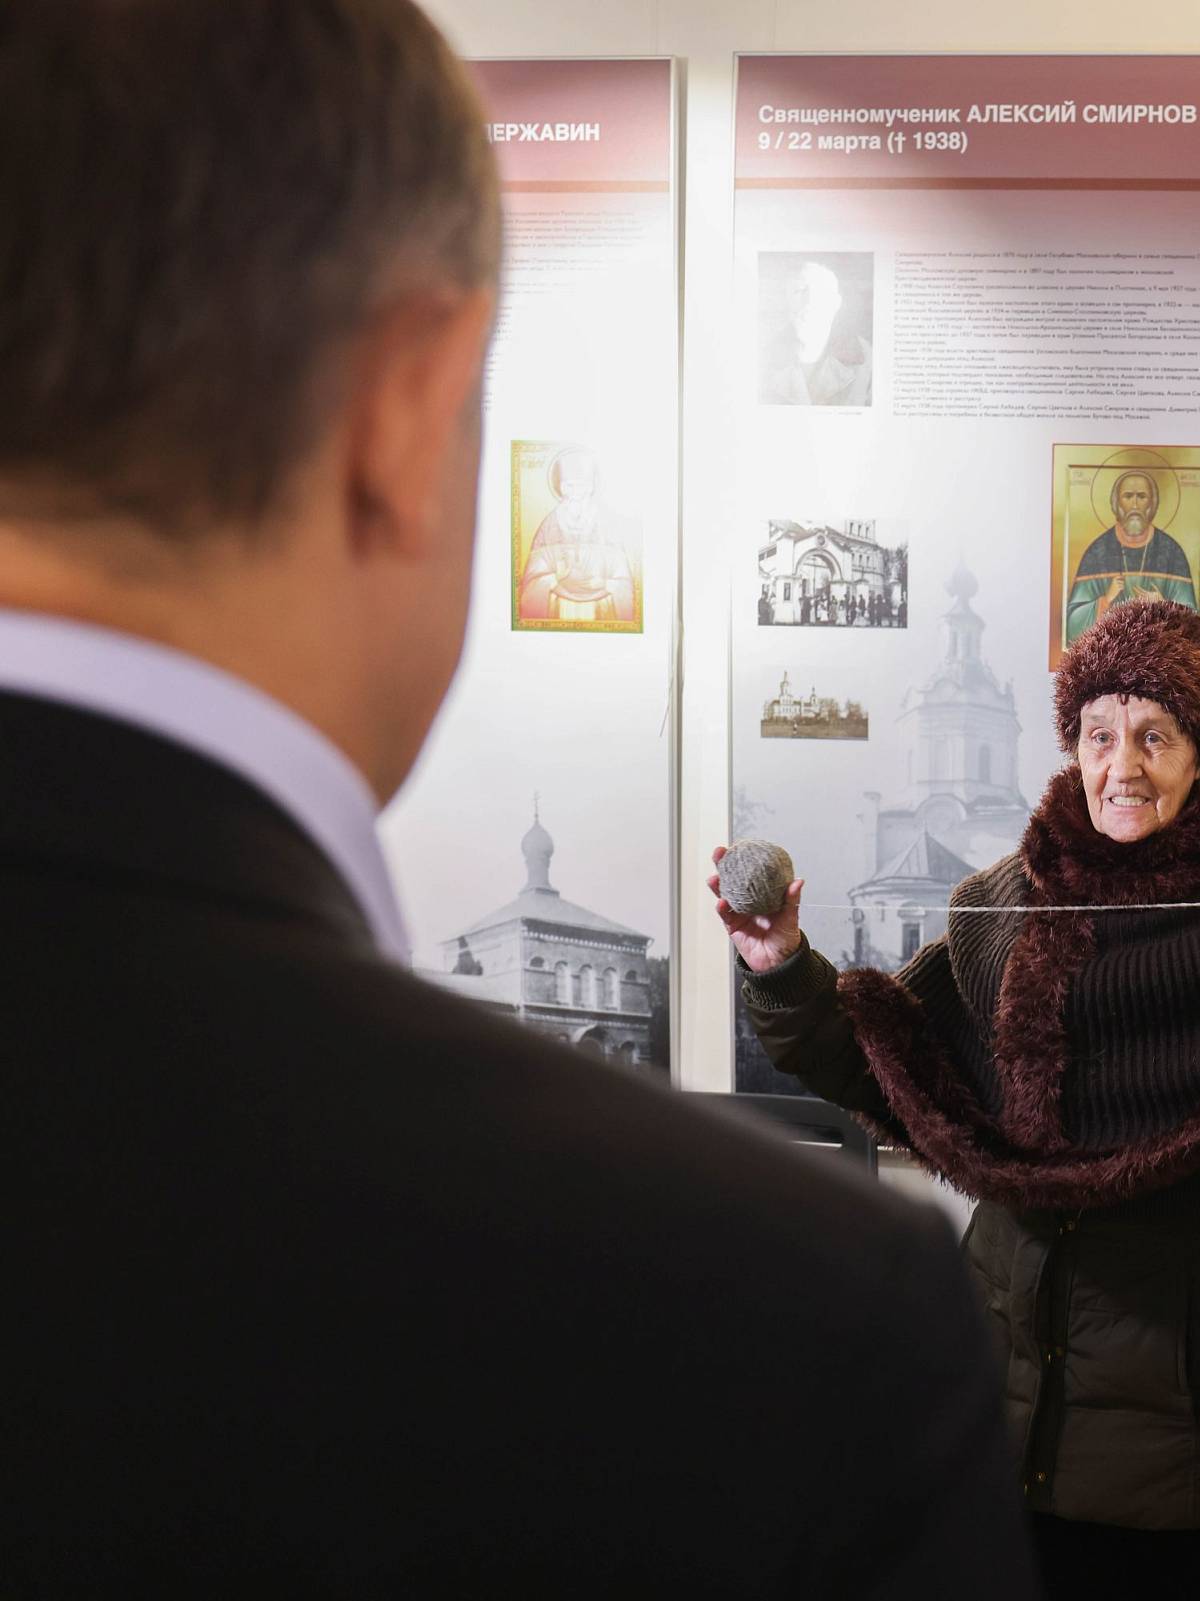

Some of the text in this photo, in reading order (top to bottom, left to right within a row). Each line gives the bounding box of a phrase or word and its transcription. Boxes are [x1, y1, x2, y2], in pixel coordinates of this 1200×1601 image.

[758, 100, 1198, 128] Священномученик АЛЕКСИЙ СМИРНОВ
[758, 132, 770, 150] 9
[775, 131, 784, 149] /
[788, 132, 812, 150] 22
[818, 135, 881, 154] марта
[912, 131, 969, 154] 1938)
